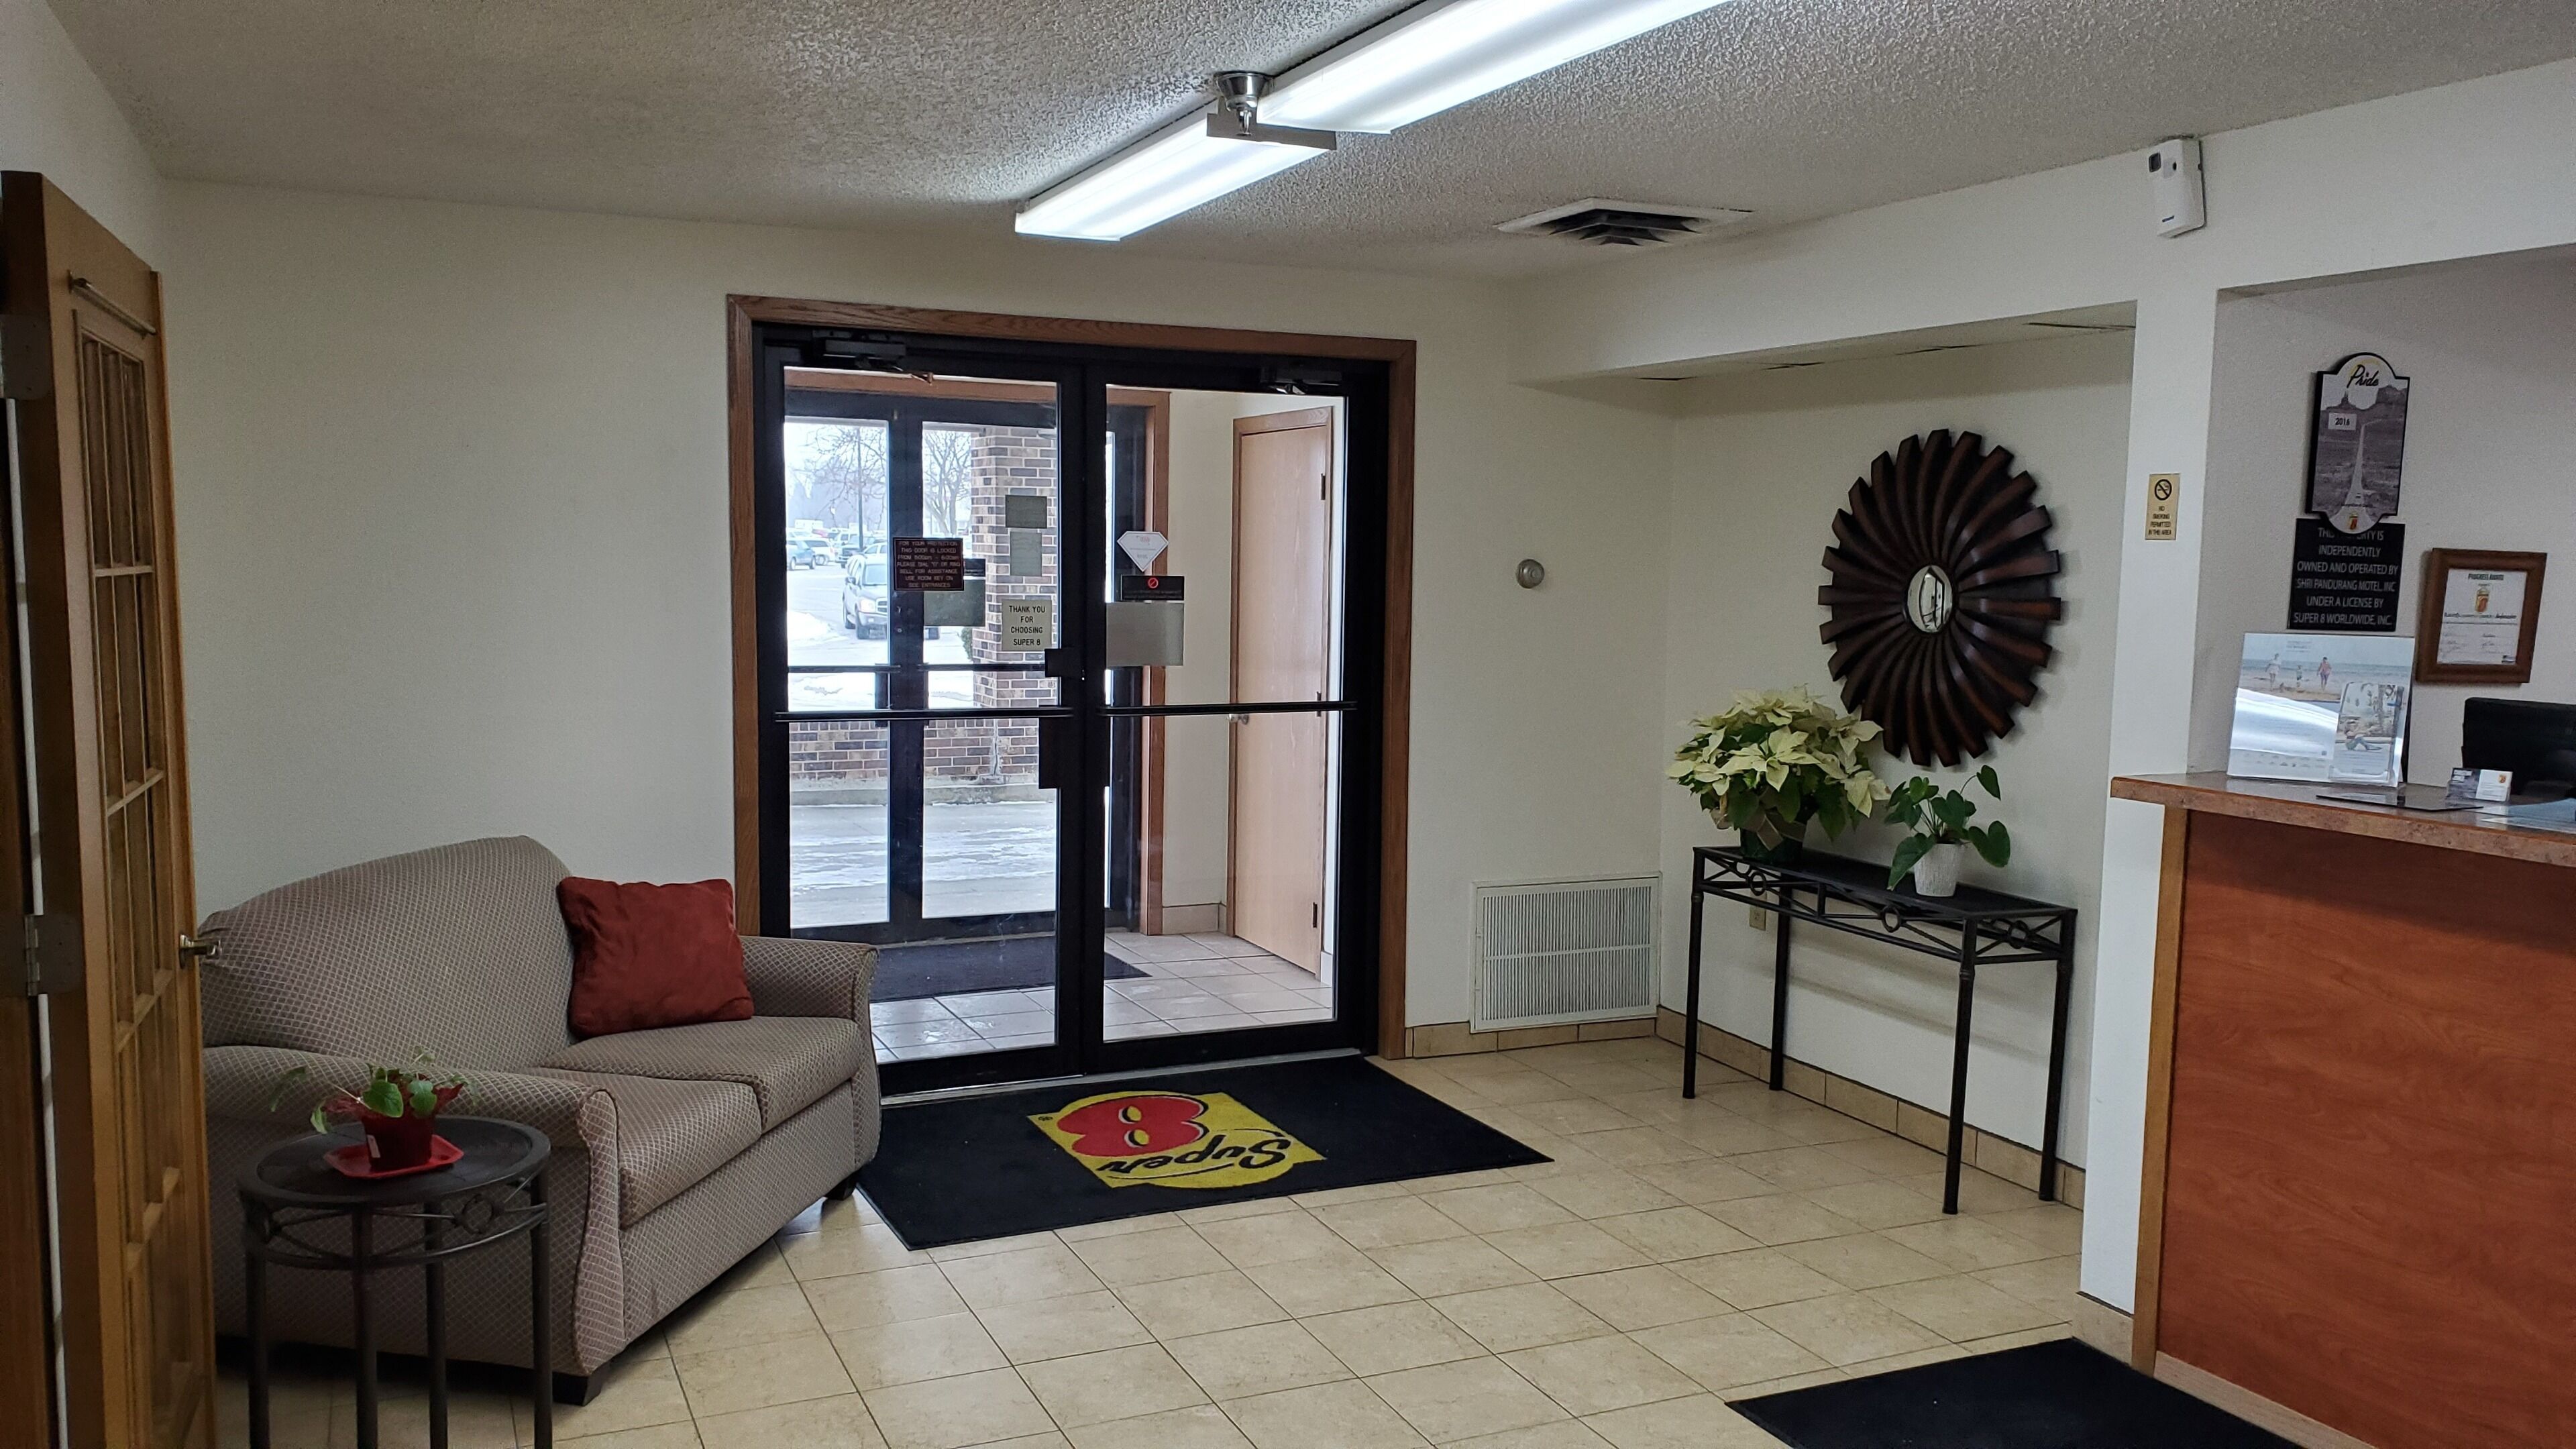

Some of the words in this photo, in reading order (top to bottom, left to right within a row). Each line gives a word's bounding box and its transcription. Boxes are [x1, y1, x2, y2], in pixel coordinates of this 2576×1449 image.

[2347, 364, 2379, 388] Pride
[2377, 531, 2385, 541] IS
[2318, 545, 2381, 558] INDEPENDENTLY
[2297, 561, 2328, 572] OWNED
[2330, 561, 2347, 573] AND
[2348, 562, 2387, 575] OPERATED
[2388, 564, 2399, 575] BY
[2297, 578, 2313, 589] SHRI
[2314, 578, 2358, 590] PANDURANG
[2306, 596, 2334, 607] UNDER
[2334, 596, 2341, 606] A
[2343, 597, 2373, 608] LICENSE
[2373, 598, 2385, 608] BY
[2294, 612, 2319, 623] SUPER
[2320, 613, 2325, 623] 8
[1010, 626, 1043, 634] CHOOSING
[1013, 638, 1034, 646] SUPER
[1056, 1095, 1210, 1157] 8
[1097, 1134, 1291, 1174] Super
